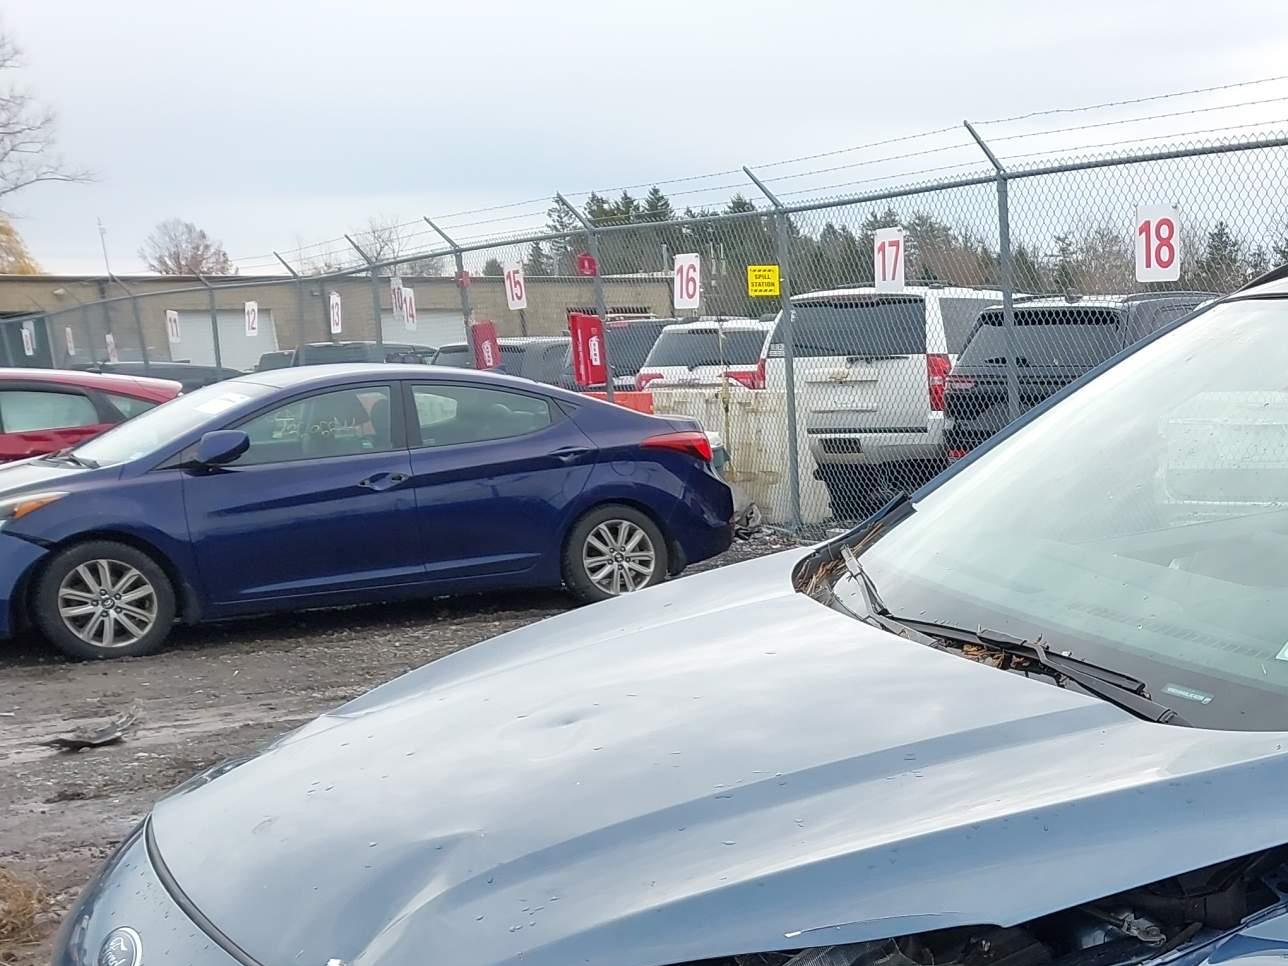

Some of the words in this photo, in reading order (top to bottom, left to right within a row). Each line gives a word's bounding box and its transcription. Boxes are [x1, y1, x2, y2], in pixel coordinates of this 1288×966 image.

[1138, 218, 1176, 269] 18
[877, 240, 900, 281] 17
[506, 269, 523, 301] 15
[676, 263, 697, 299] 16
[247, 308, 257, 331] 12
[331, 302, 340, 327] 13
[404, 296, 415, 323] 14
